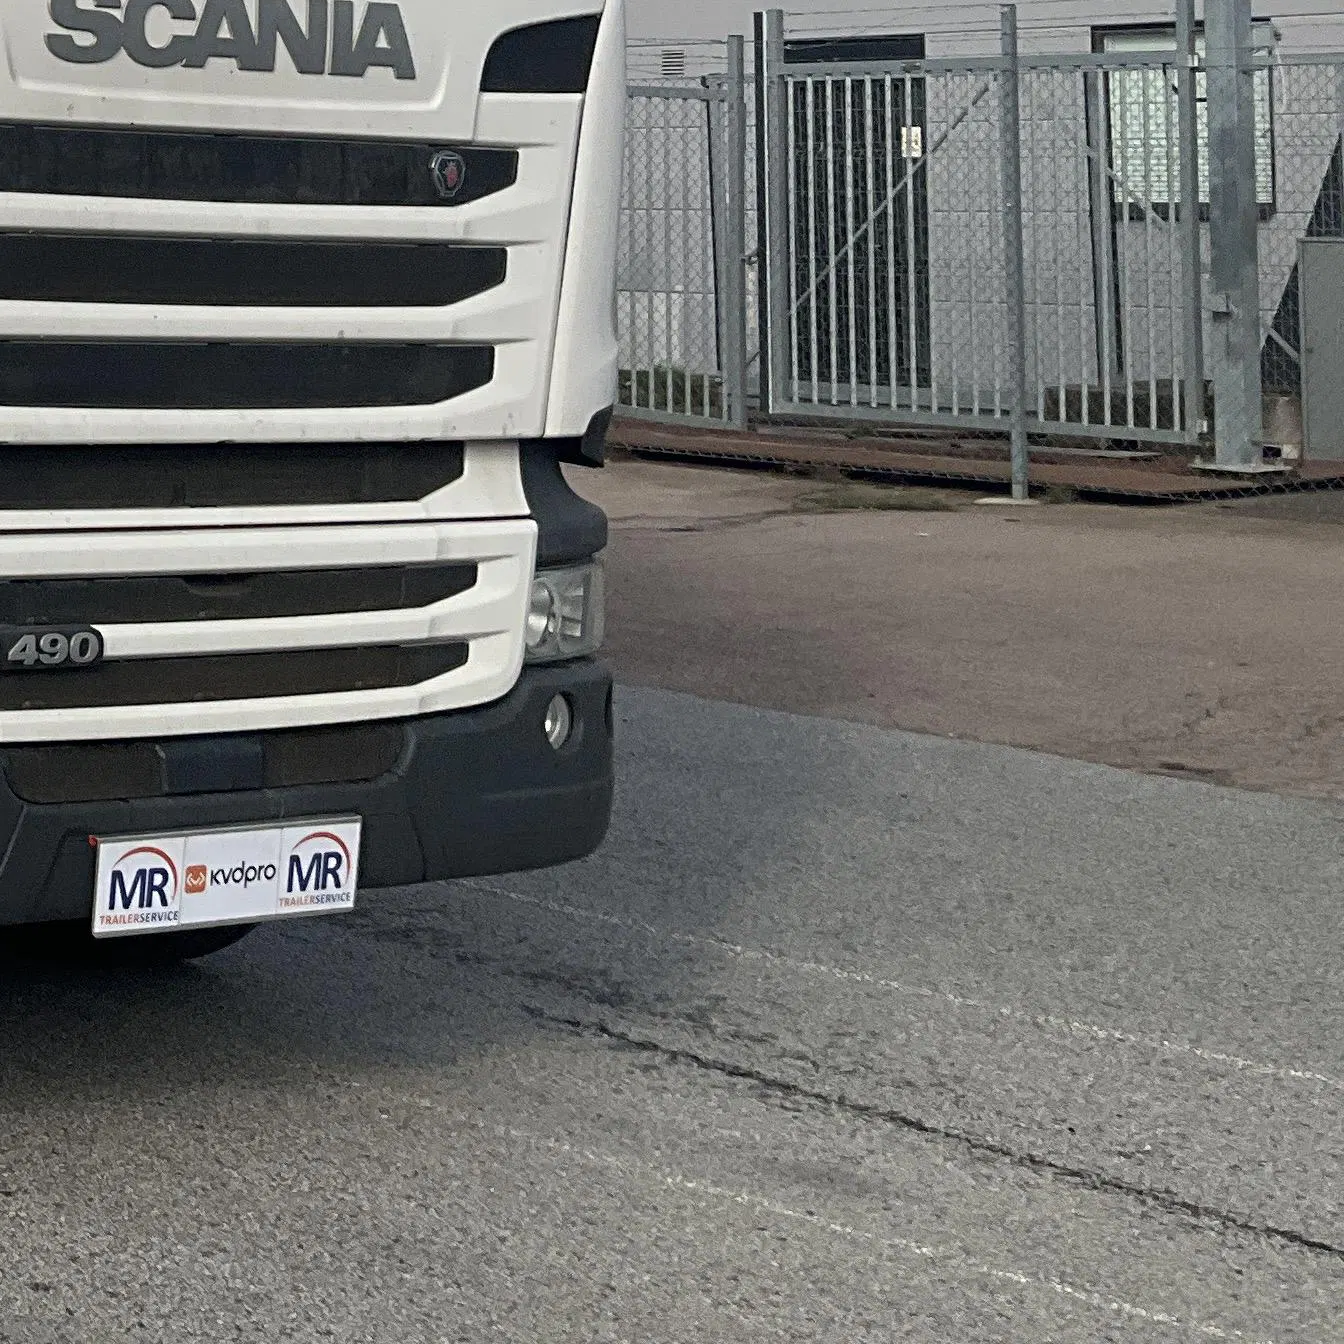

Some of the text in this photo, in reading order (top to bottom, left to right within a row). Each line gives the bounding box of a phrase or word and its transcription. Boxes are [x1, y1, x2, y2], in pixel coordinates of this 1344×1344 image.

[7, 631, 99, 666] 490
[108, 867, 170, 911] MR
[210, 860, 277, 889] kvdpro
[287, 851, 343, 894] MR
